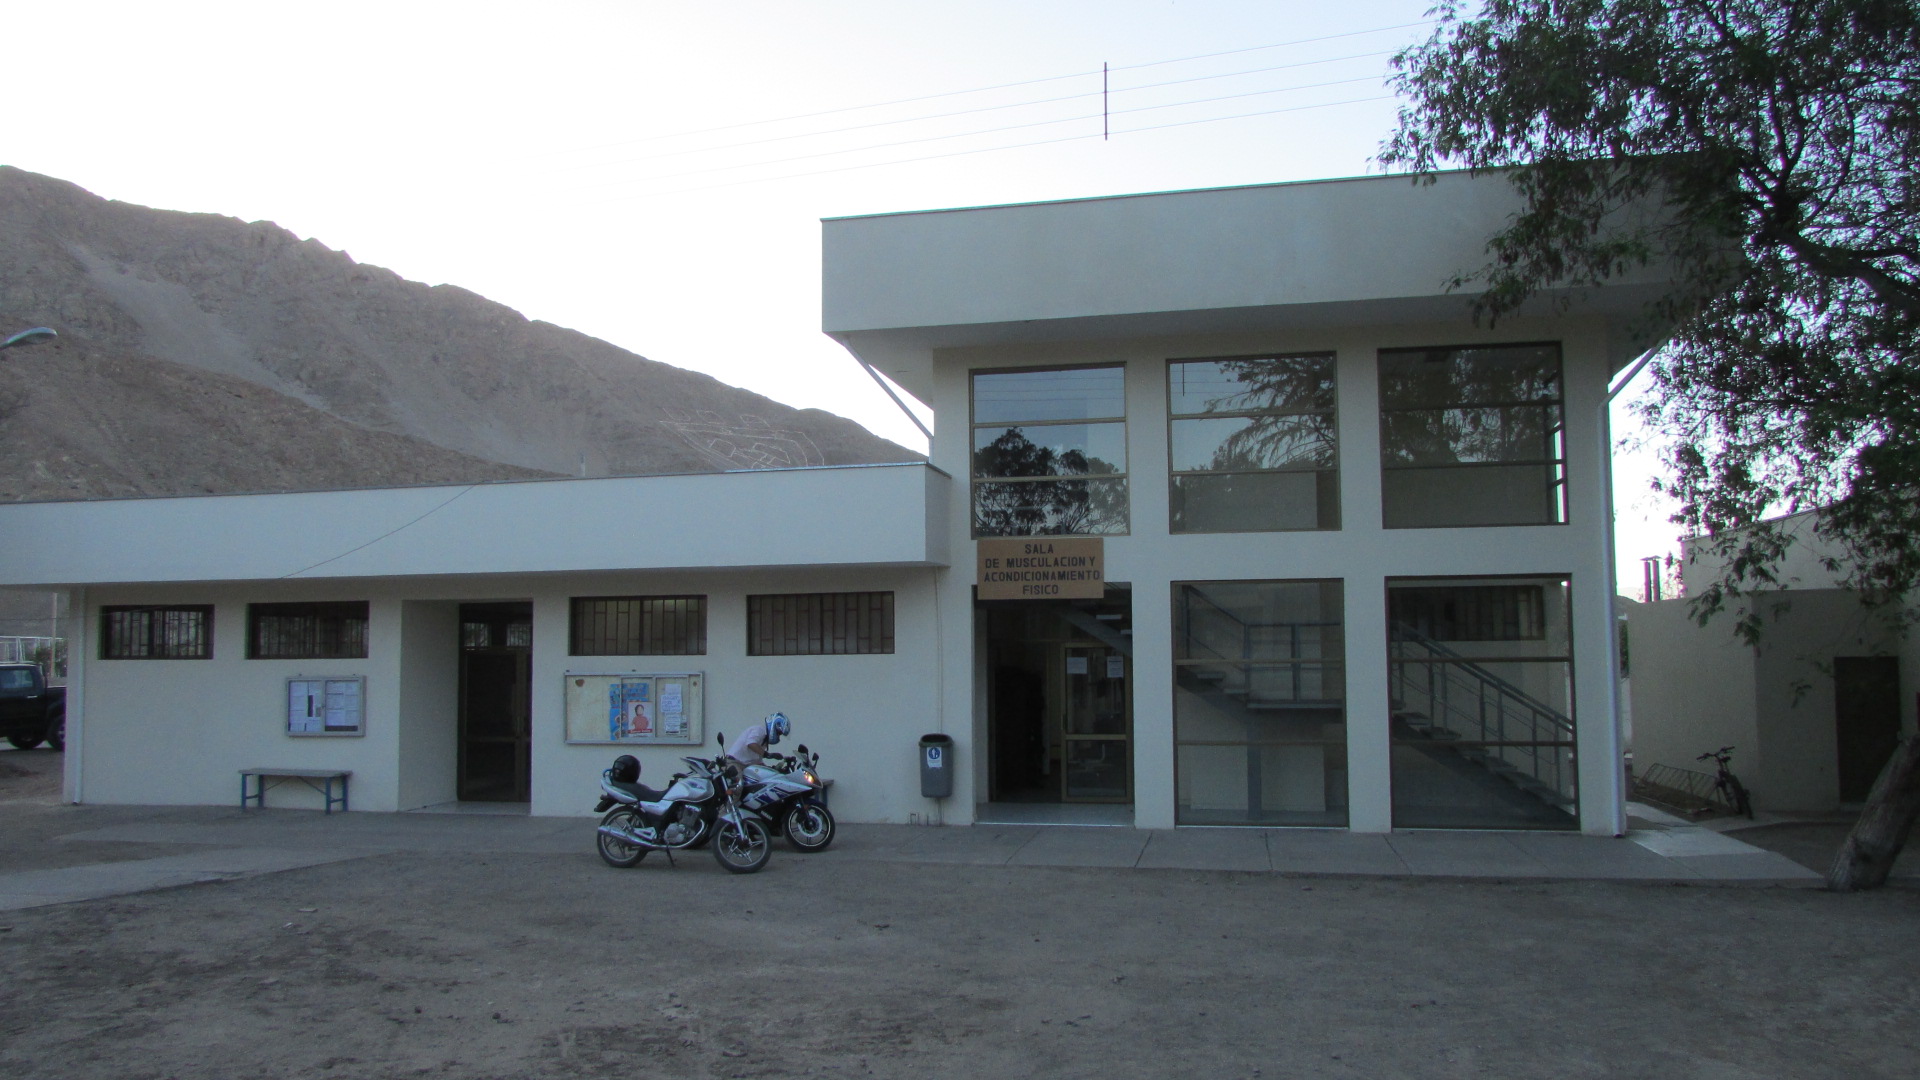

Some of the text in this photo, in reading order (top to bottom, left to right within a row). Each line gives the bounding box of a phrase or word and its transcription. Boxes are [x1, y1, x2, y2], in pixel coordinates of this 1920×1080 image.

[1025, 543, 1054, 554] SALA
[985, 556, 1096, 569] DE MUSCULACION Y
[984, 570, 1101, 582] ACONDICIONAMIENTO
[1022, 584, 1059, 595] FISICO
